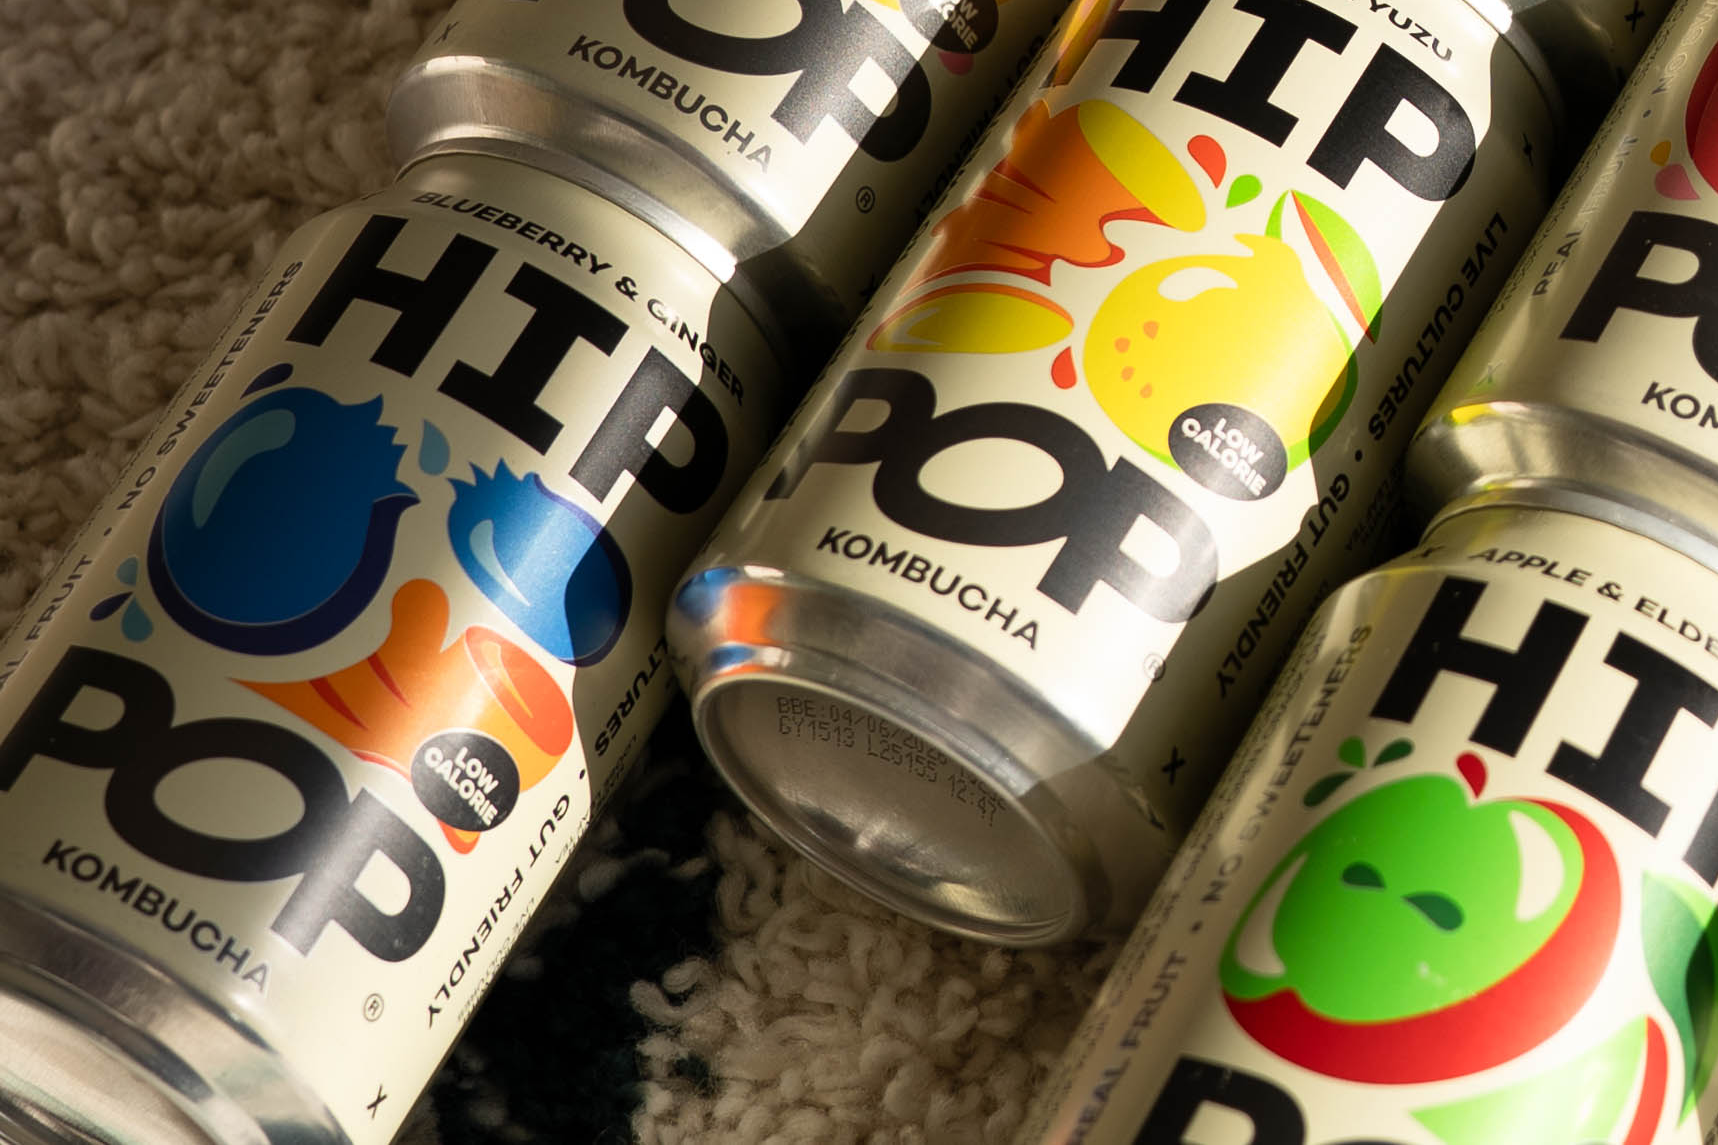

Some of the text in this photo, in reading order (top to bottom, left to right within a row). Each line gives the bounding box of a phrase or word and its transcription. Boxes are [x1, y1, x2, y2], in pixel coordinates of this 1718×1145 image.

[567, 35, 776, 173] KOMBUCHA
[412, 191, 745, 408] BLUEBERRY & GINGER
[1461, 211, 1511, 289] LIVE
[1532, 224, 1588, 299] REAL
[285, 214, 728, 515] HIP
[1368, 284, 1465, 441] CULTURES
[25, 259, 306, 644] FRUIT NO SWEETENERS
[763, 367, 1218, 624] POP
[1181, 417, 1267, 497] CALORIE
[1212, 416, 1265, 465] LOW
[1308, 472, 1351, 545] GUT
[817, 525, 1041, 650] KOMBUCHA
[1217, 538, 1310, 699] FRIENDLY
[1474, 546, 1593, 588] APPLE
[1596, 580, 1625, 603] &
[0, 645, 446, 963] POP
[423, 746, 499, 828] CALORIE
[425, 633, 674, 1031] LTURES GUT FRIENDLY
[454, 745, 500, 795] LOW
[1119, 949, 1189, 1054] FRUIT
[1200, 854, 1243, 906] NO
[1239, 622, 1376, 848] SWEETENERS
[42, 839, 273, 996] KOMBUCHA
